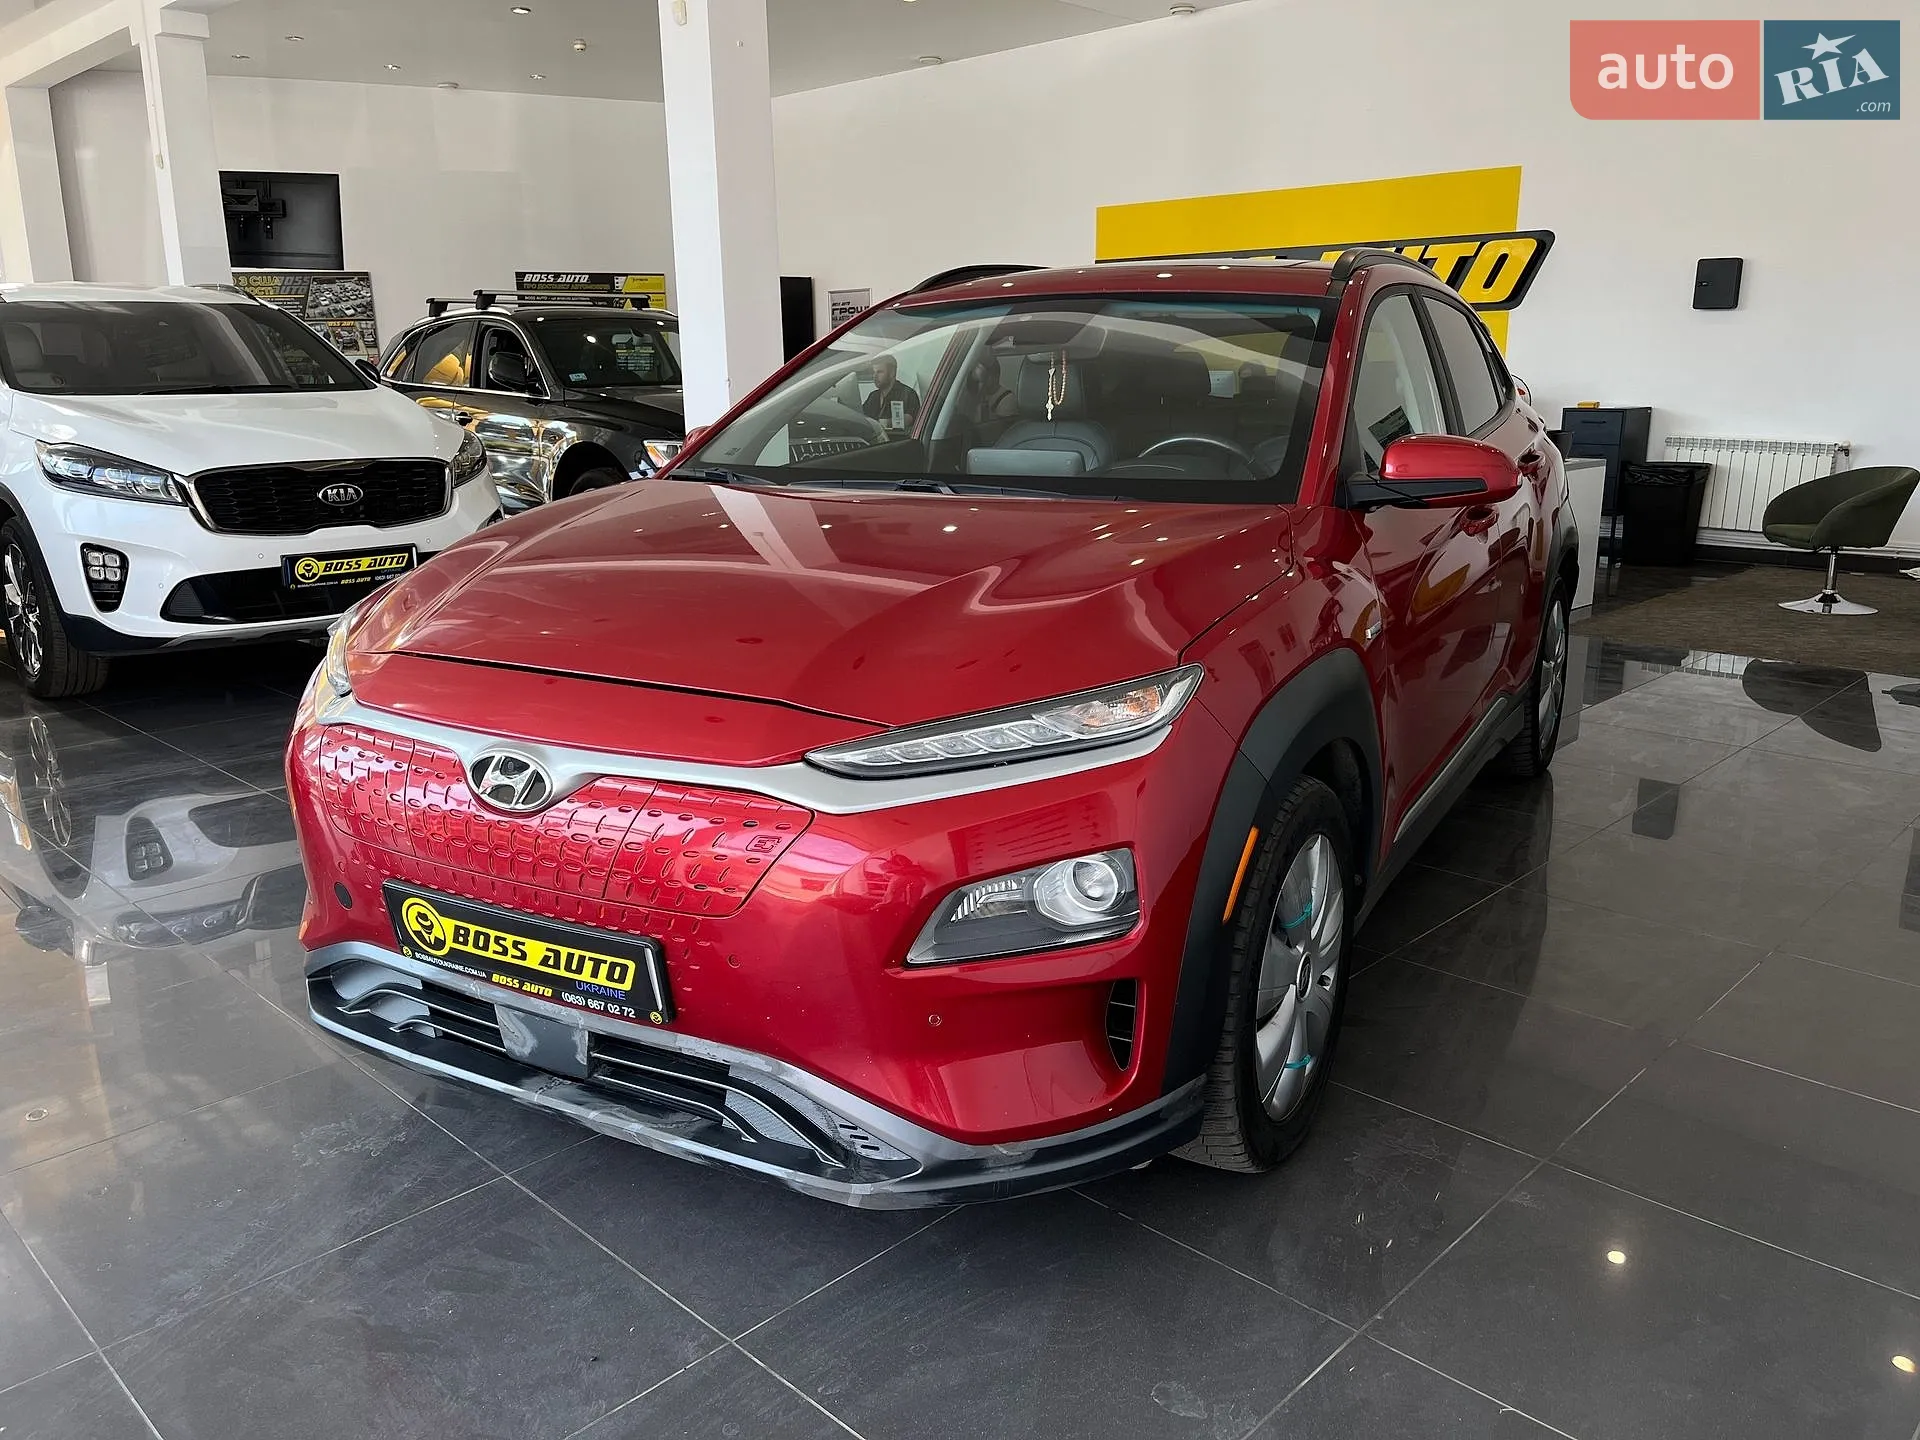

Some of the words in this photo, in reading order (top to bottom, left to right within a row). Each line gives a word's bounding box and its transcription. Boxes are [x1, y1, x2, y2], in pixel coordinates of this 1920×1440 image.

[523, 273, 555, 282] BOSS
[557, 274, 590, 283] AUTO
[326, 487, 358, 501] KIA
[323, 561, 362, 573] BOSS
[366, 555, 407, 568] AUTO
[452, 923, 528, 961] BOSS
[538, 947, 629, 985] AUTO
[491, 973, 520, 989] BOSS
[522, 981, 553, 997] AUTO
[561, 991, 586, 1006] (063)
[587, 998, 606, 1011] 667
[607, 1004, 621, 1015] 02
[621, 1006, 636, 1019] 72
[575, 980, 627, 1001] UKRAINE
